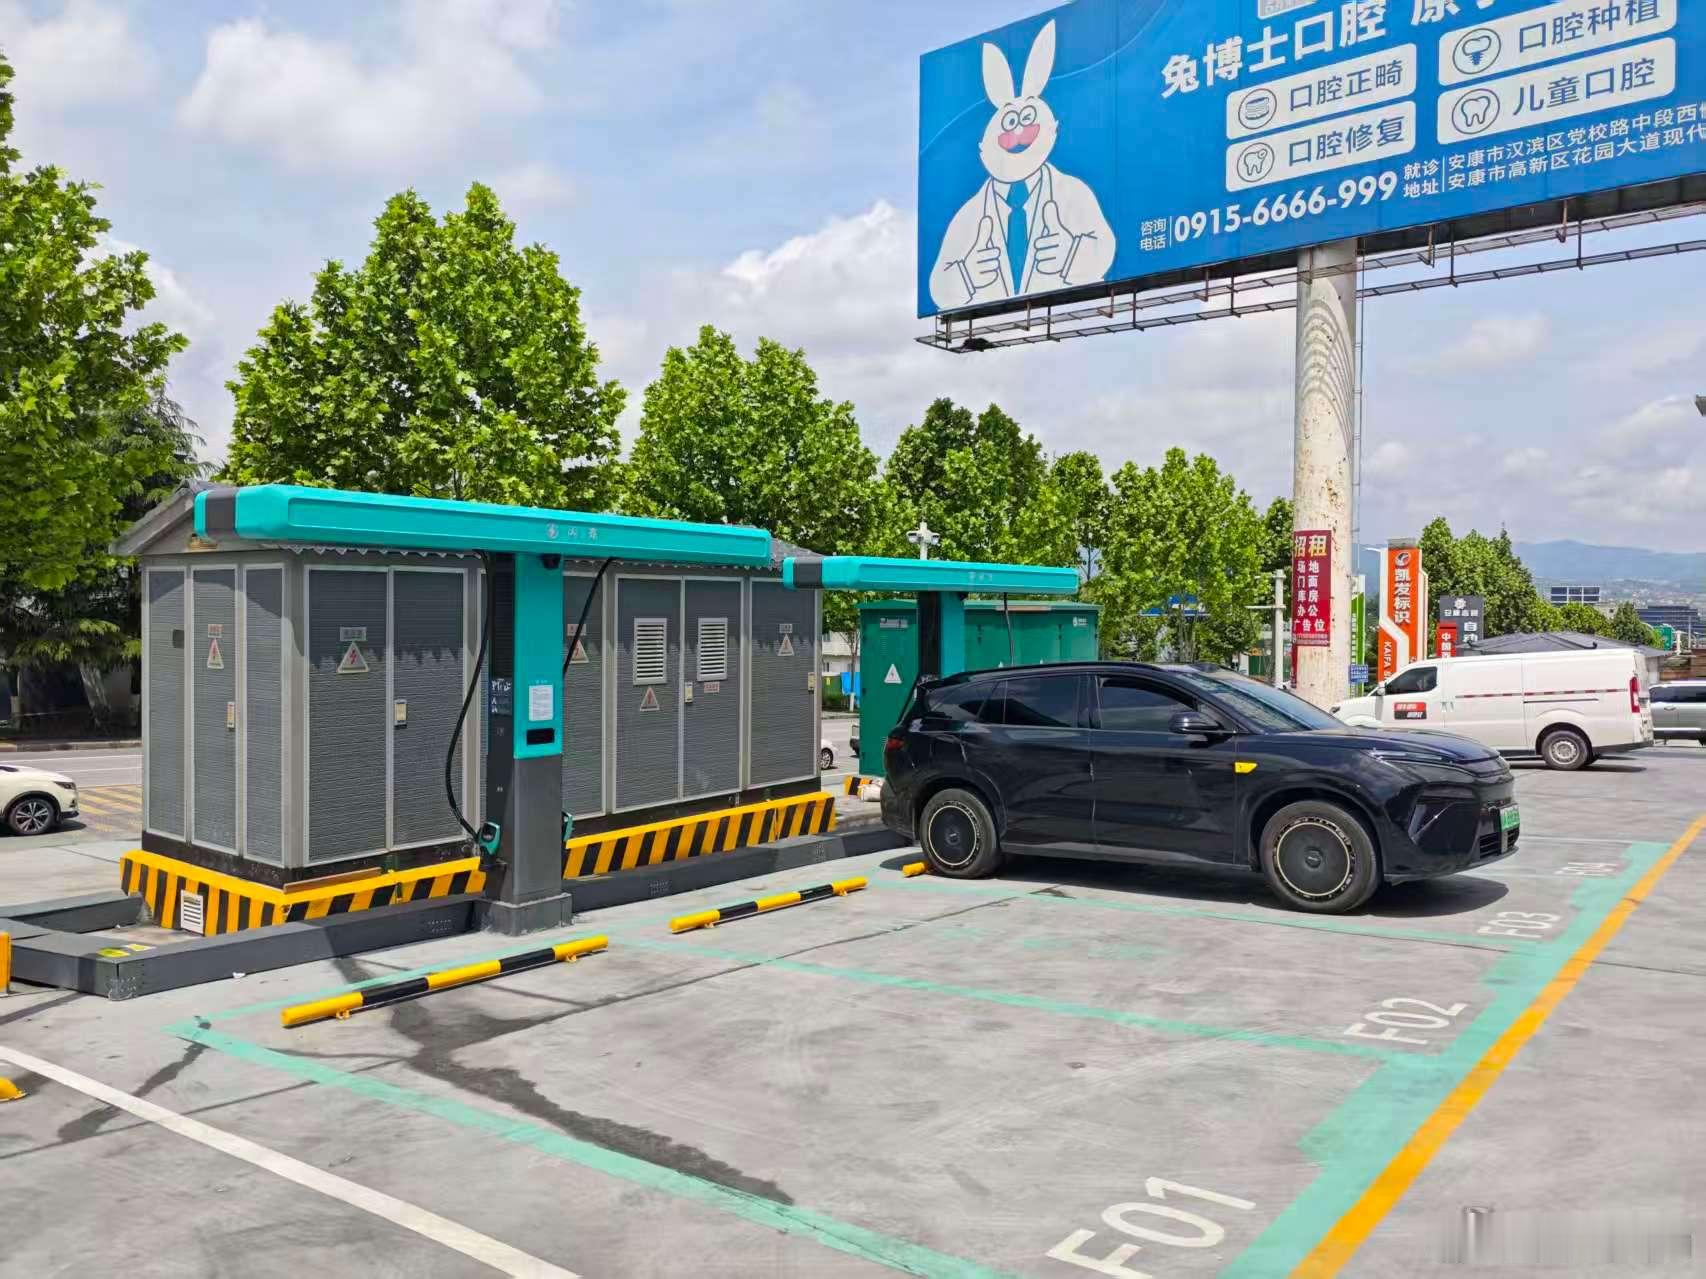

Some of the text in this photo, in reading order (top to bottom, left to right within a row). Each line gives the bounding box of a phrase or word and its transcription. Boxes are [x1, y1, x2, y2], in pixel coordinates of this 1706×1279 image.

[1518, 0, 1661, 53] 口腔种植
[1161, 0, 1388, 99] 兔博士口腔
[1289, 59, 1404, 112] 口腔正畸
[1512, 57, 1656, 116] 儿童口腔
[1288, 115, 1405, 167] 口腔修复
[1402, 179, 1440, 199] 地址
[1403, 158, 1443, 181] 就诊
[1174, 170, 1398, 242] 0915-6666-999
[1139, 236, 1167, 251] 电话
[1140, 218, 1167, 236] 咨询
[1294, 535, 1328, 558] 招租
[1293, 619, 1326, 632] 广告位
[1383, 641, 1392, 668] KAIFA
[1476, 910, 1562, 939] F03
[1343, 997, 1468, 1046] F02
[1046, 1176, 1257, 1279] F01
